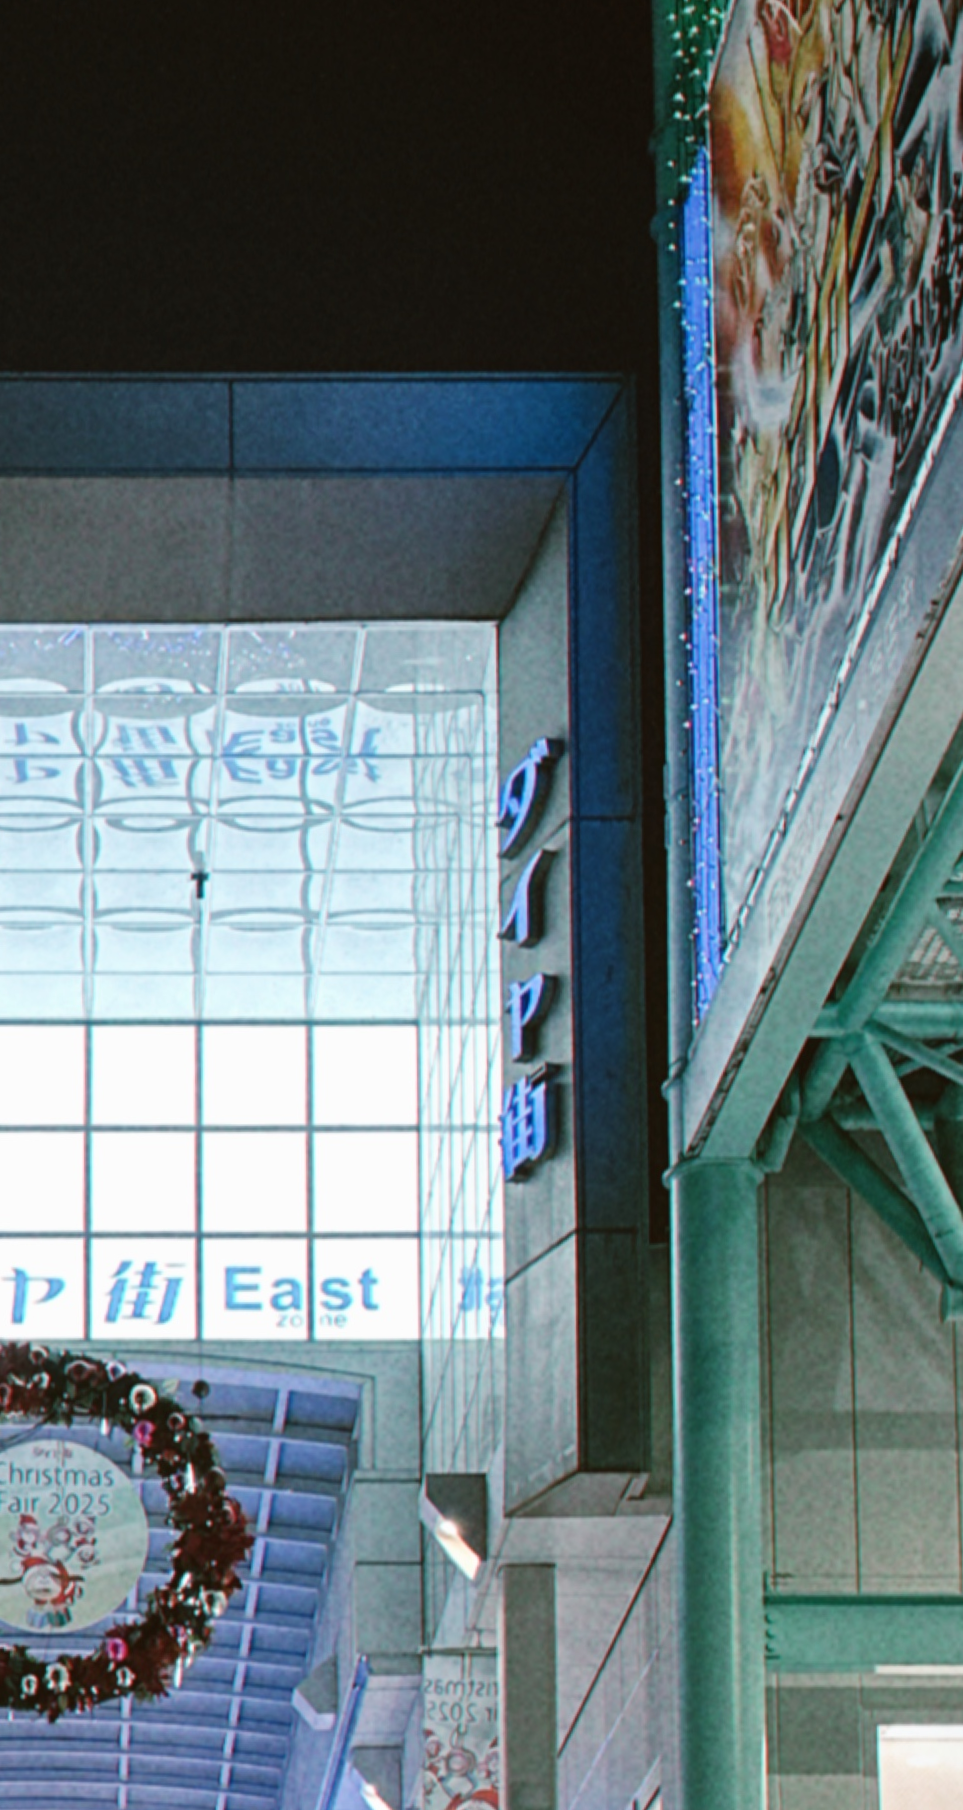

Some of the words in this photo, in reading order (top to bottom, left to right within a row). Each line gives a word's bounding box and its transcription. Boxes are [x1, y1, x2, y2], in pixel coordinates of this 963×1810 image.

[496, 738, 557, 1183] ダイヤ街
[224, 1266, 379, 1311] East
[276, 1313, 347, 1328] zone
[48, 1493, 110, 1517] 2025
